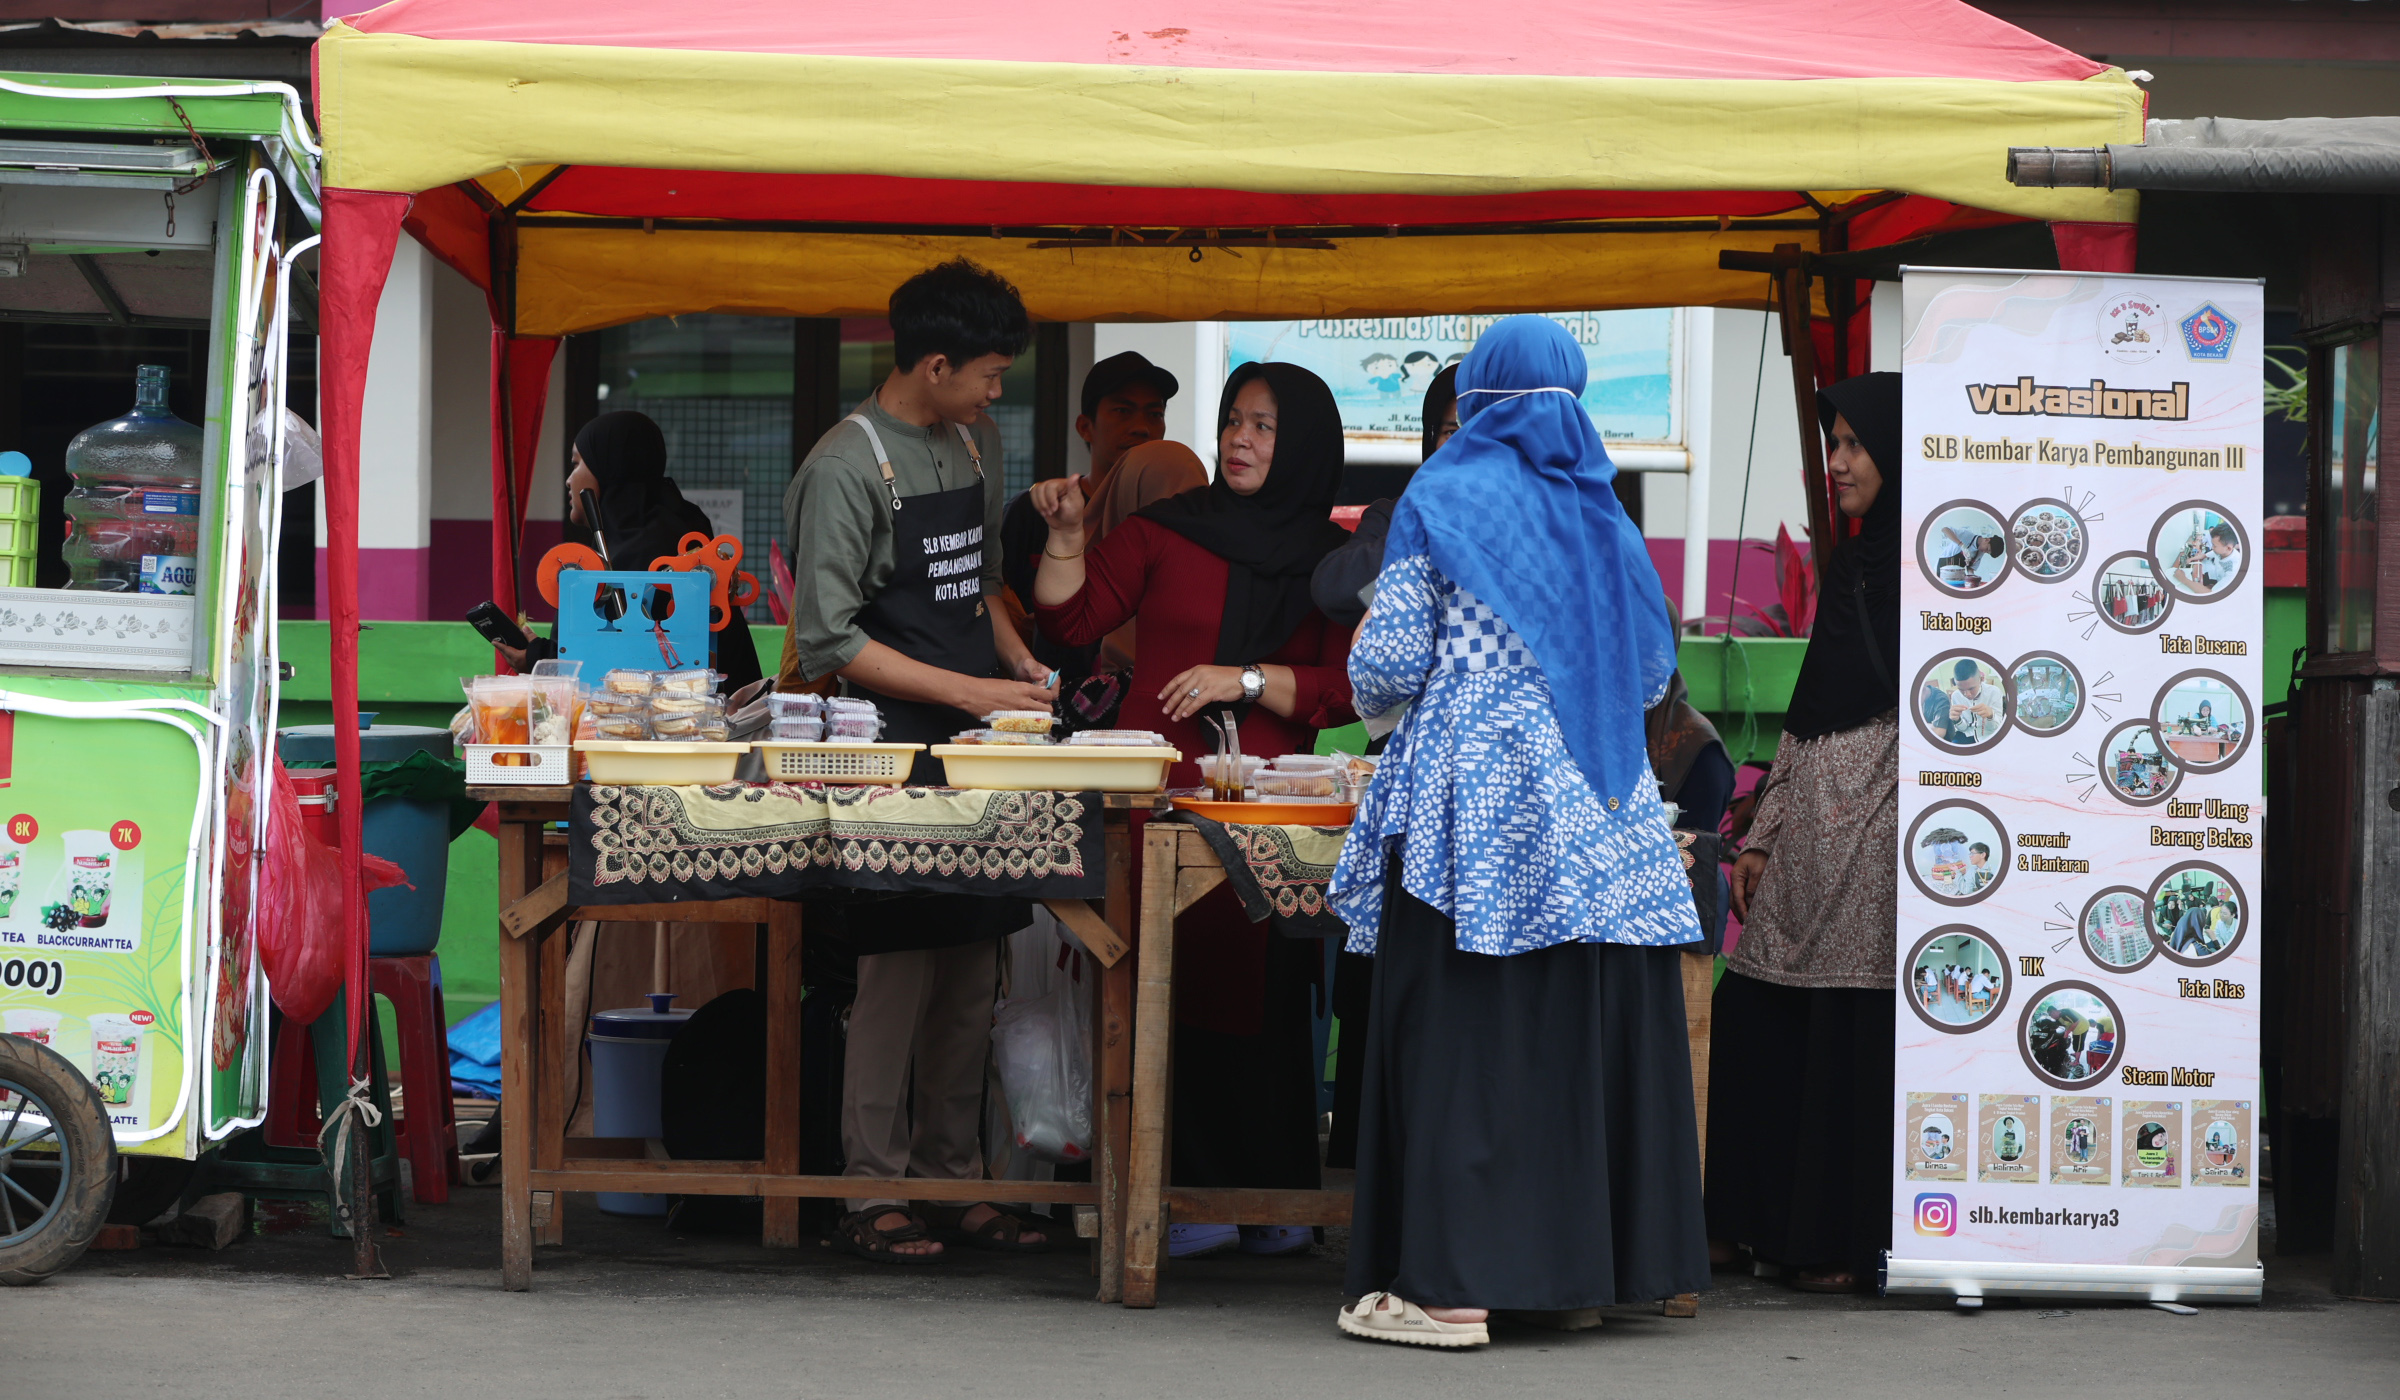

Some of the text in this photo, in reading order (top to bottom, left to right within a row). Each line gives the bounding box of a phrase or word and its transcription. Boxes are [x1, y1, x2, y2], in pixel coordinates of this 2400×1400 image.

[1965, 376, 2190, 421] vokasional
[1923, 437, 2244, 471] SLB kembar Karya Pembangunan III
[923, 537, 939, 554] SLB
[939, 532, 968, 553] KEMBAR
[161, 566, 196, 588] AQU
[935, 576, 981, 602] KOTA BEKASI
[1921, 611, 1992, 635] Tata boga
[2160, 634, 2247, 656] Tata Busana
[1919, 770, 1982, 788] meronce
[2167, 798, 2249, 823] daur Ulang
[15, 822, 31, 837] 8K
[118, 828, 133, 843] 7K
[2151, 826, 2253, 851] Barang Bekas
[2018, 832, 2071, 850] souvenir
[2018, 855, 2090, 874] & Hantaran
[2, 931, 26, 944] TEA
[37, 934, 133, 950] BLACKCURRANT TEA
[0, 959, 63, 996] 00)
[2019, 956, 2045, 978] TIK
[2179, 978, 2246, 1000] Tata Rias
[131, 1014, 152, 1023] NEW!
[2122, 1065, 2216, 1088] Steam Motor
[108, 1115, 138, 1125] LATTE
[1969, 1206, 2120, 1230] slb.kembarkarya3
